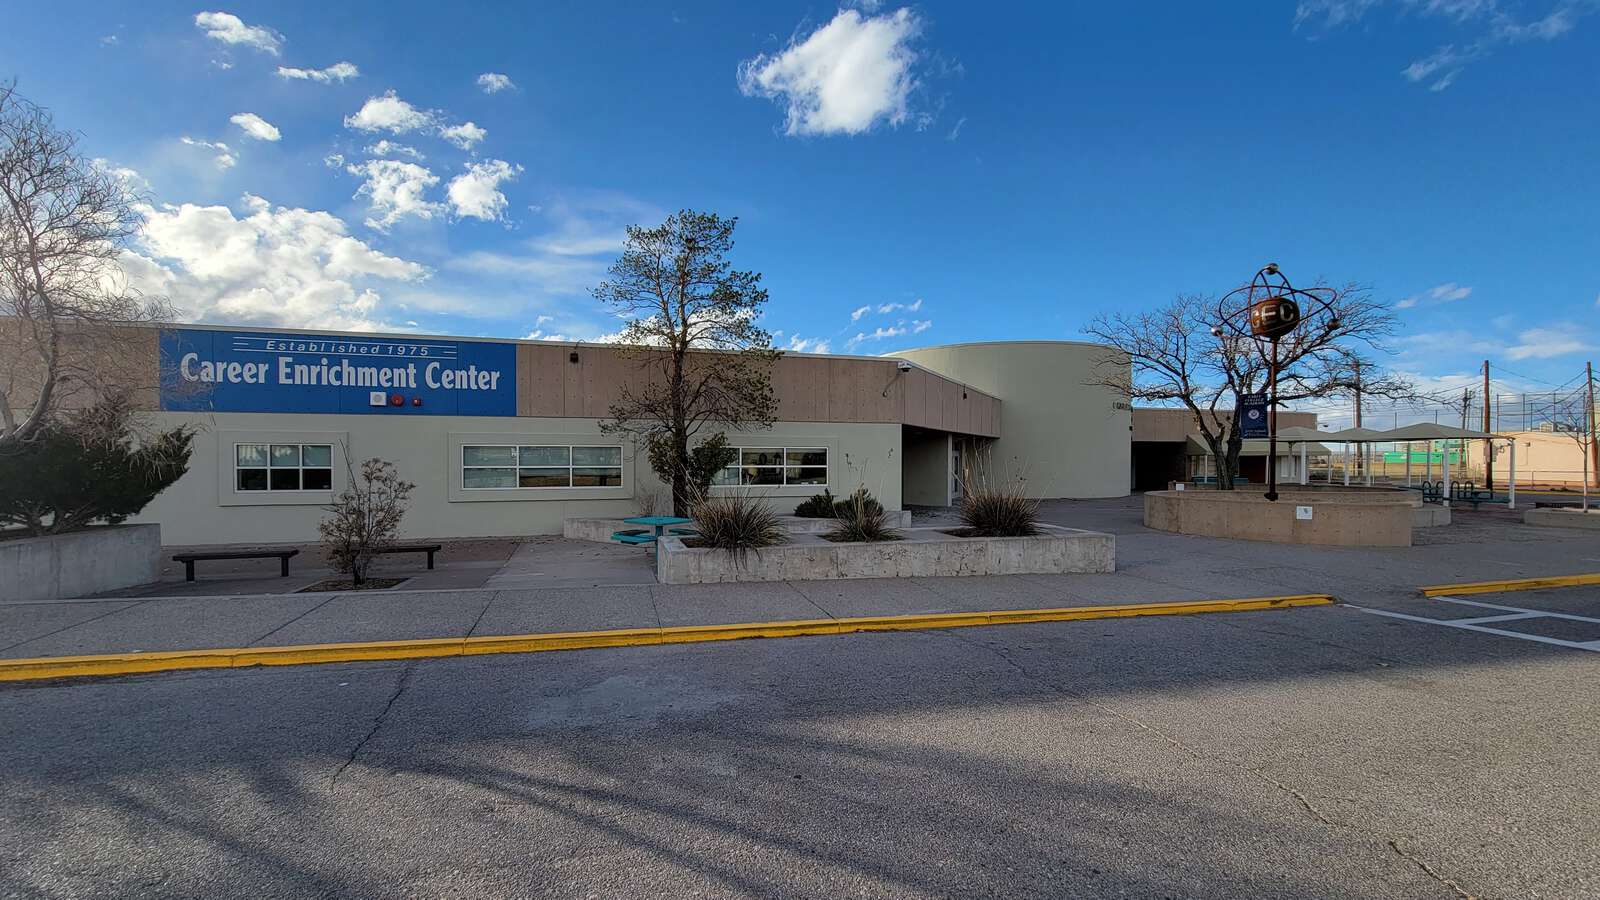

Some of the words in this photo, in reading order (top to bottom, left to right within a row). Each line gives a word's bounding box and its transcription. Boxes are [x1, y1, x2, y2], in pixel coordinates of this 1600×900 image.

[266, 340, 380, 355] Established
[387, 346, 430, 356] 1975
[180, 352, 269, 384] Career
[278, 356, 417, 388] Enrichment
[425, 361, 501, 390] Center
